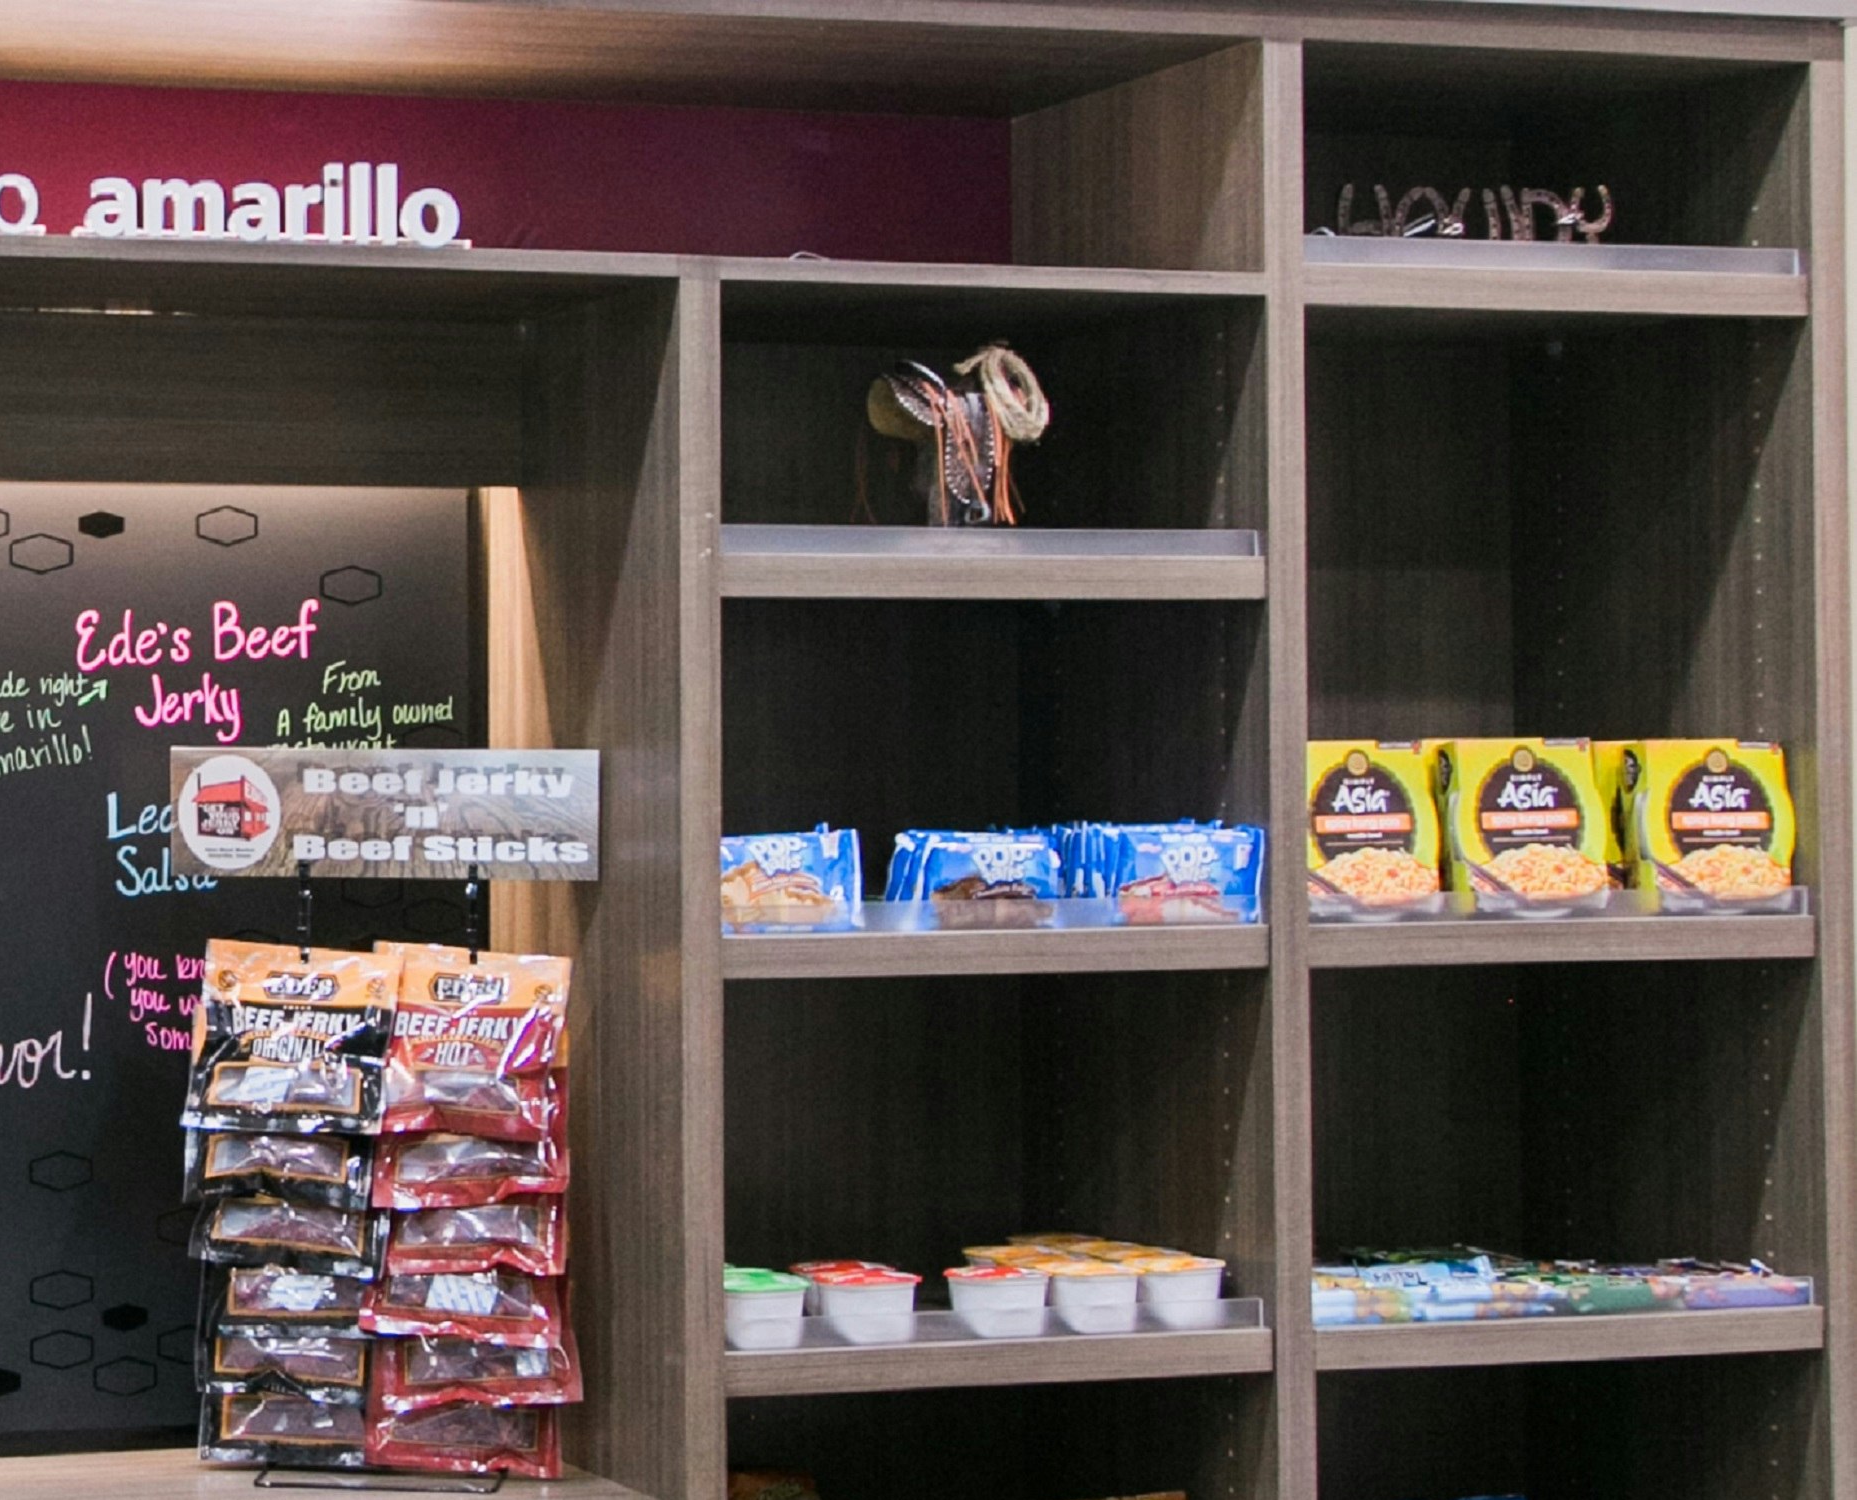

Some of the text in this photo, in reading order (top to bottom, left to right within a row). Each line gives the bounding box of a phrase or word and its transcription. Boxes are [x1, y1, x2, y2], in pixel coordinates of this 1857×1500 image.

[88, 163, 461, 248] amarillo
[76, 598, 319, 672] Ede's Beef
[41, 673, 89, 699] right
[323, 660, 381, 695] From
[26, 709, 61, 730] in
[135, 673, 241, 742] Jerky
[276, 696, 454, 741] A family owned
[303, 767, 575, 800] Beef Jerky
[292, 834, 589, 863] Beef Sticks
[395, 1012, 450, 1037] BEEF
[434, 1041, 474, 1067] HOT
